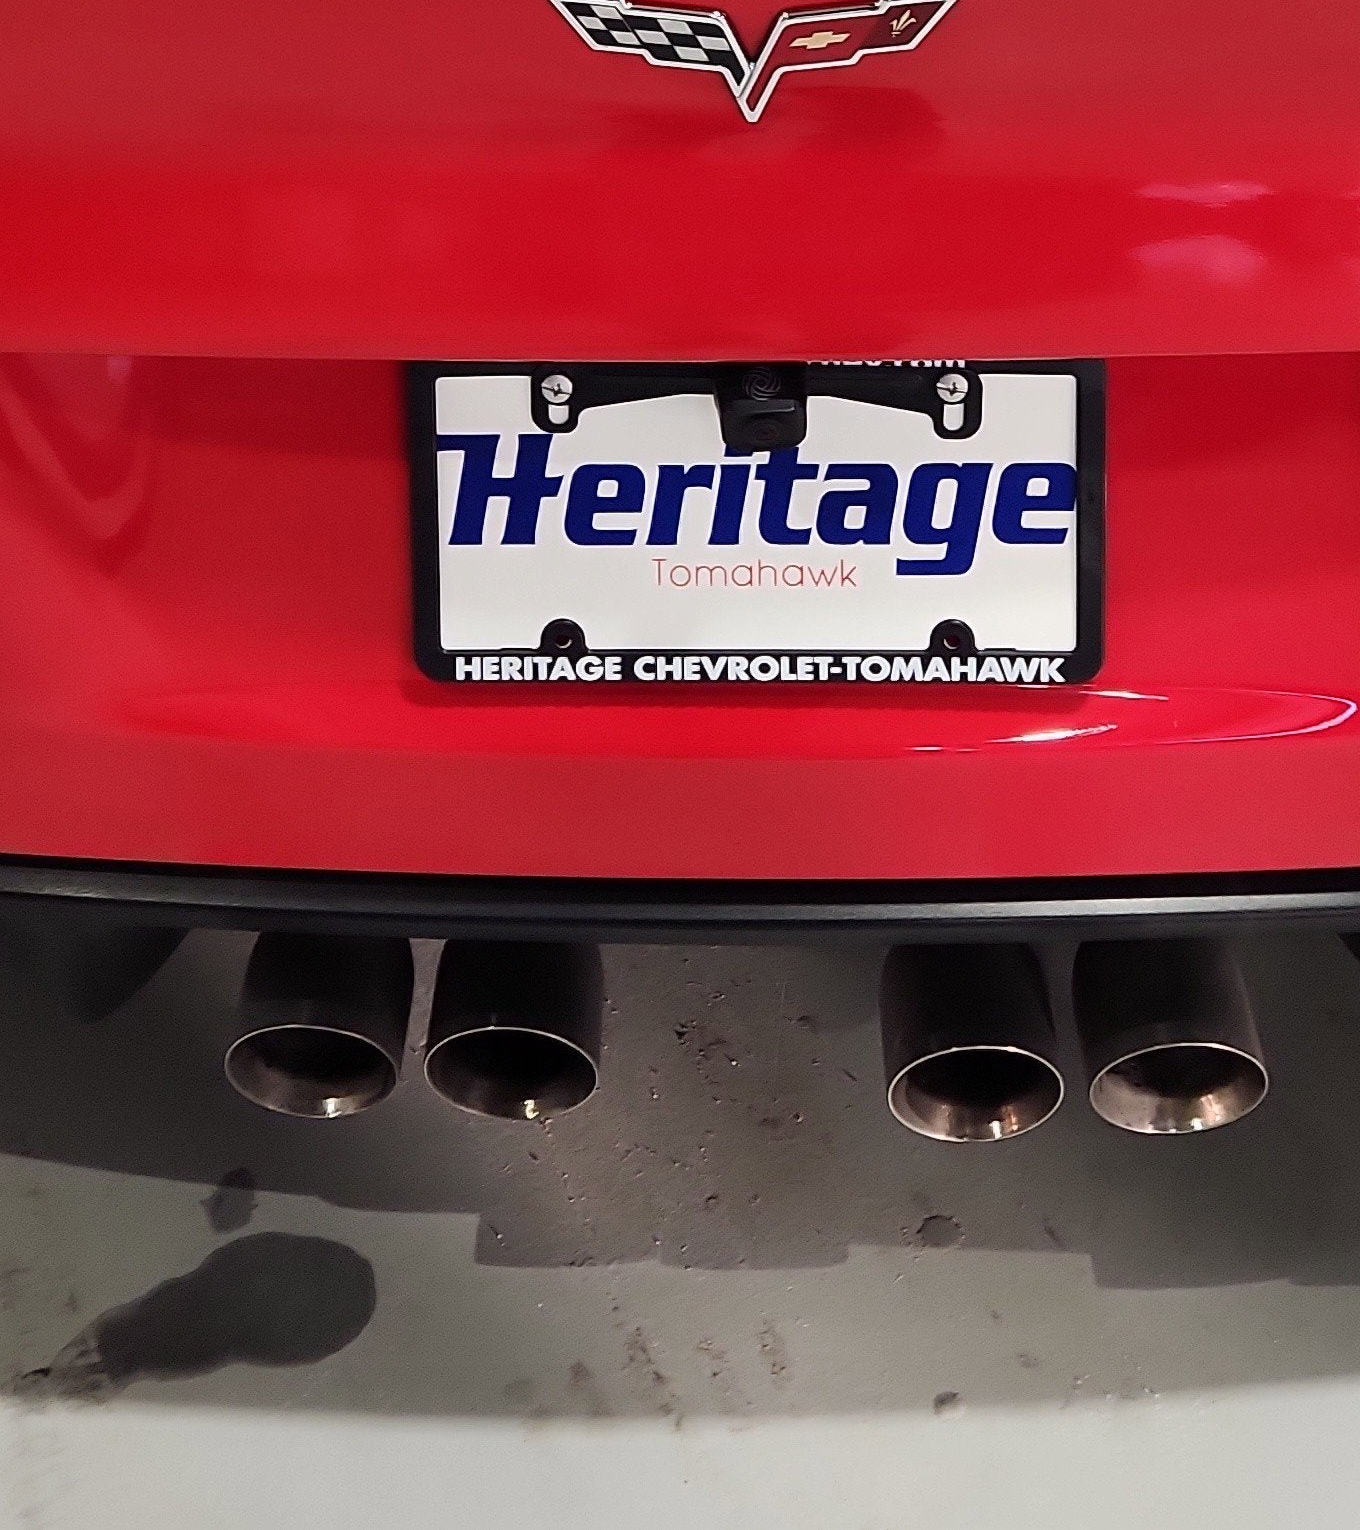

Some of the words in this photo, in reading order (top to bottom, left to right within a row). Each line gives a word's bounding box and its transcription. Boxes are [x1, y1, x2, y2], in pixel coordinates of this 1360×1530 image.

[436, 432, 1077, 576] Heritage
[652, 557, 859, 588] Tomahawk
[455, 655, 623, 682] HERITAGE
[633, 656, 1065, 683] CHEVROLET-TOMAHAWK
